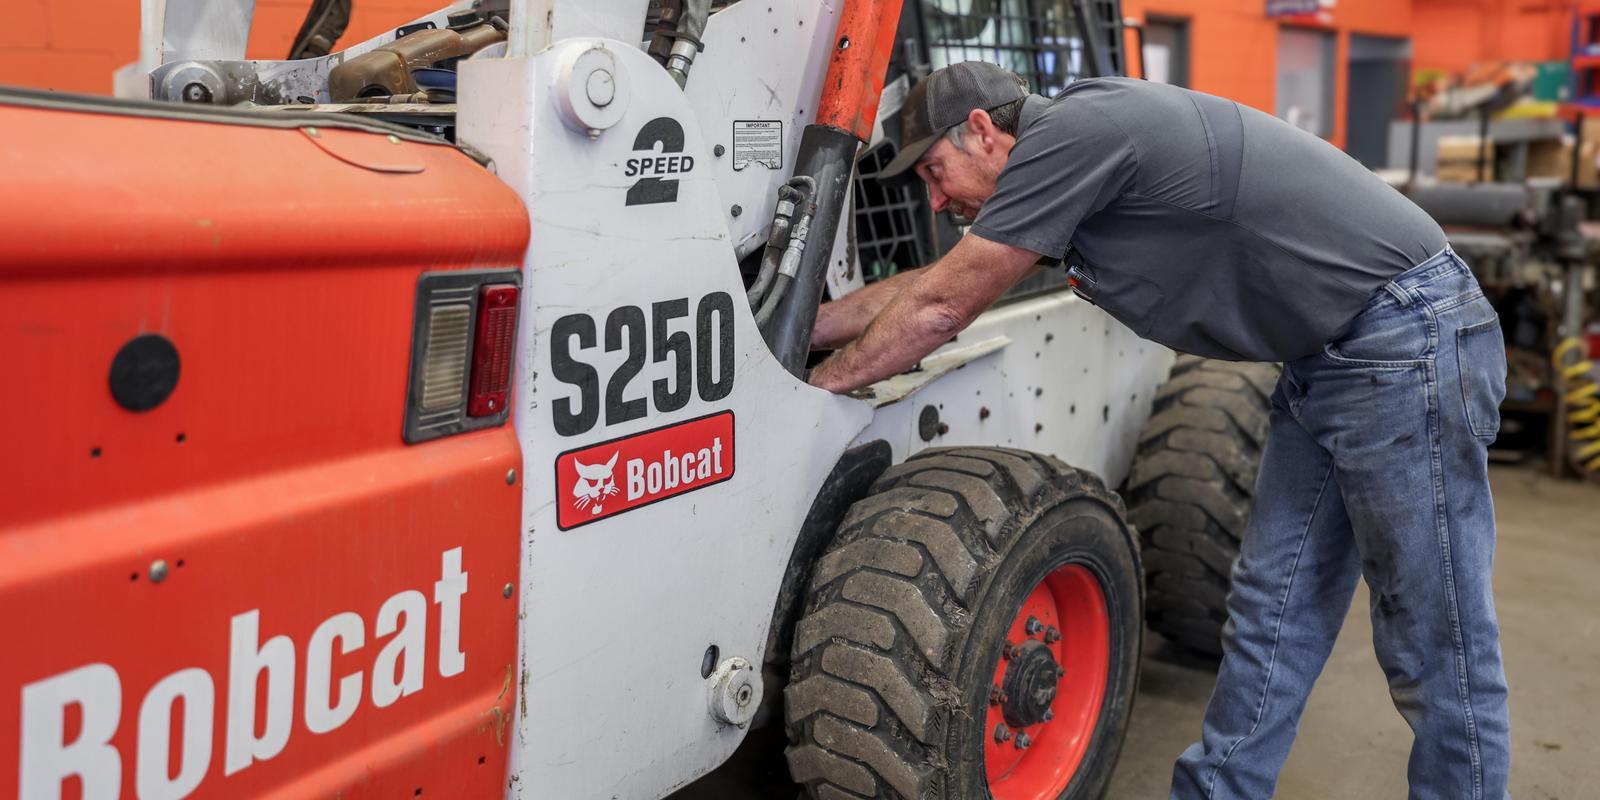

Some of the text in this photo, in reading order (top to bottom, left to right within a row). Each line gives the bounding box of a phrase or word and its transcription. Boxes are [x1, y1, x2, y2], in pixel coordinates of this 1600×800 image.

[625, 117, 685, 206] 2
[625, 156, 694, 177] SPEED
[550, 291, 735, 437] S250
[626, 437, 723, 502] Bobcat
[19, 546, 469, 800] Bobcat
